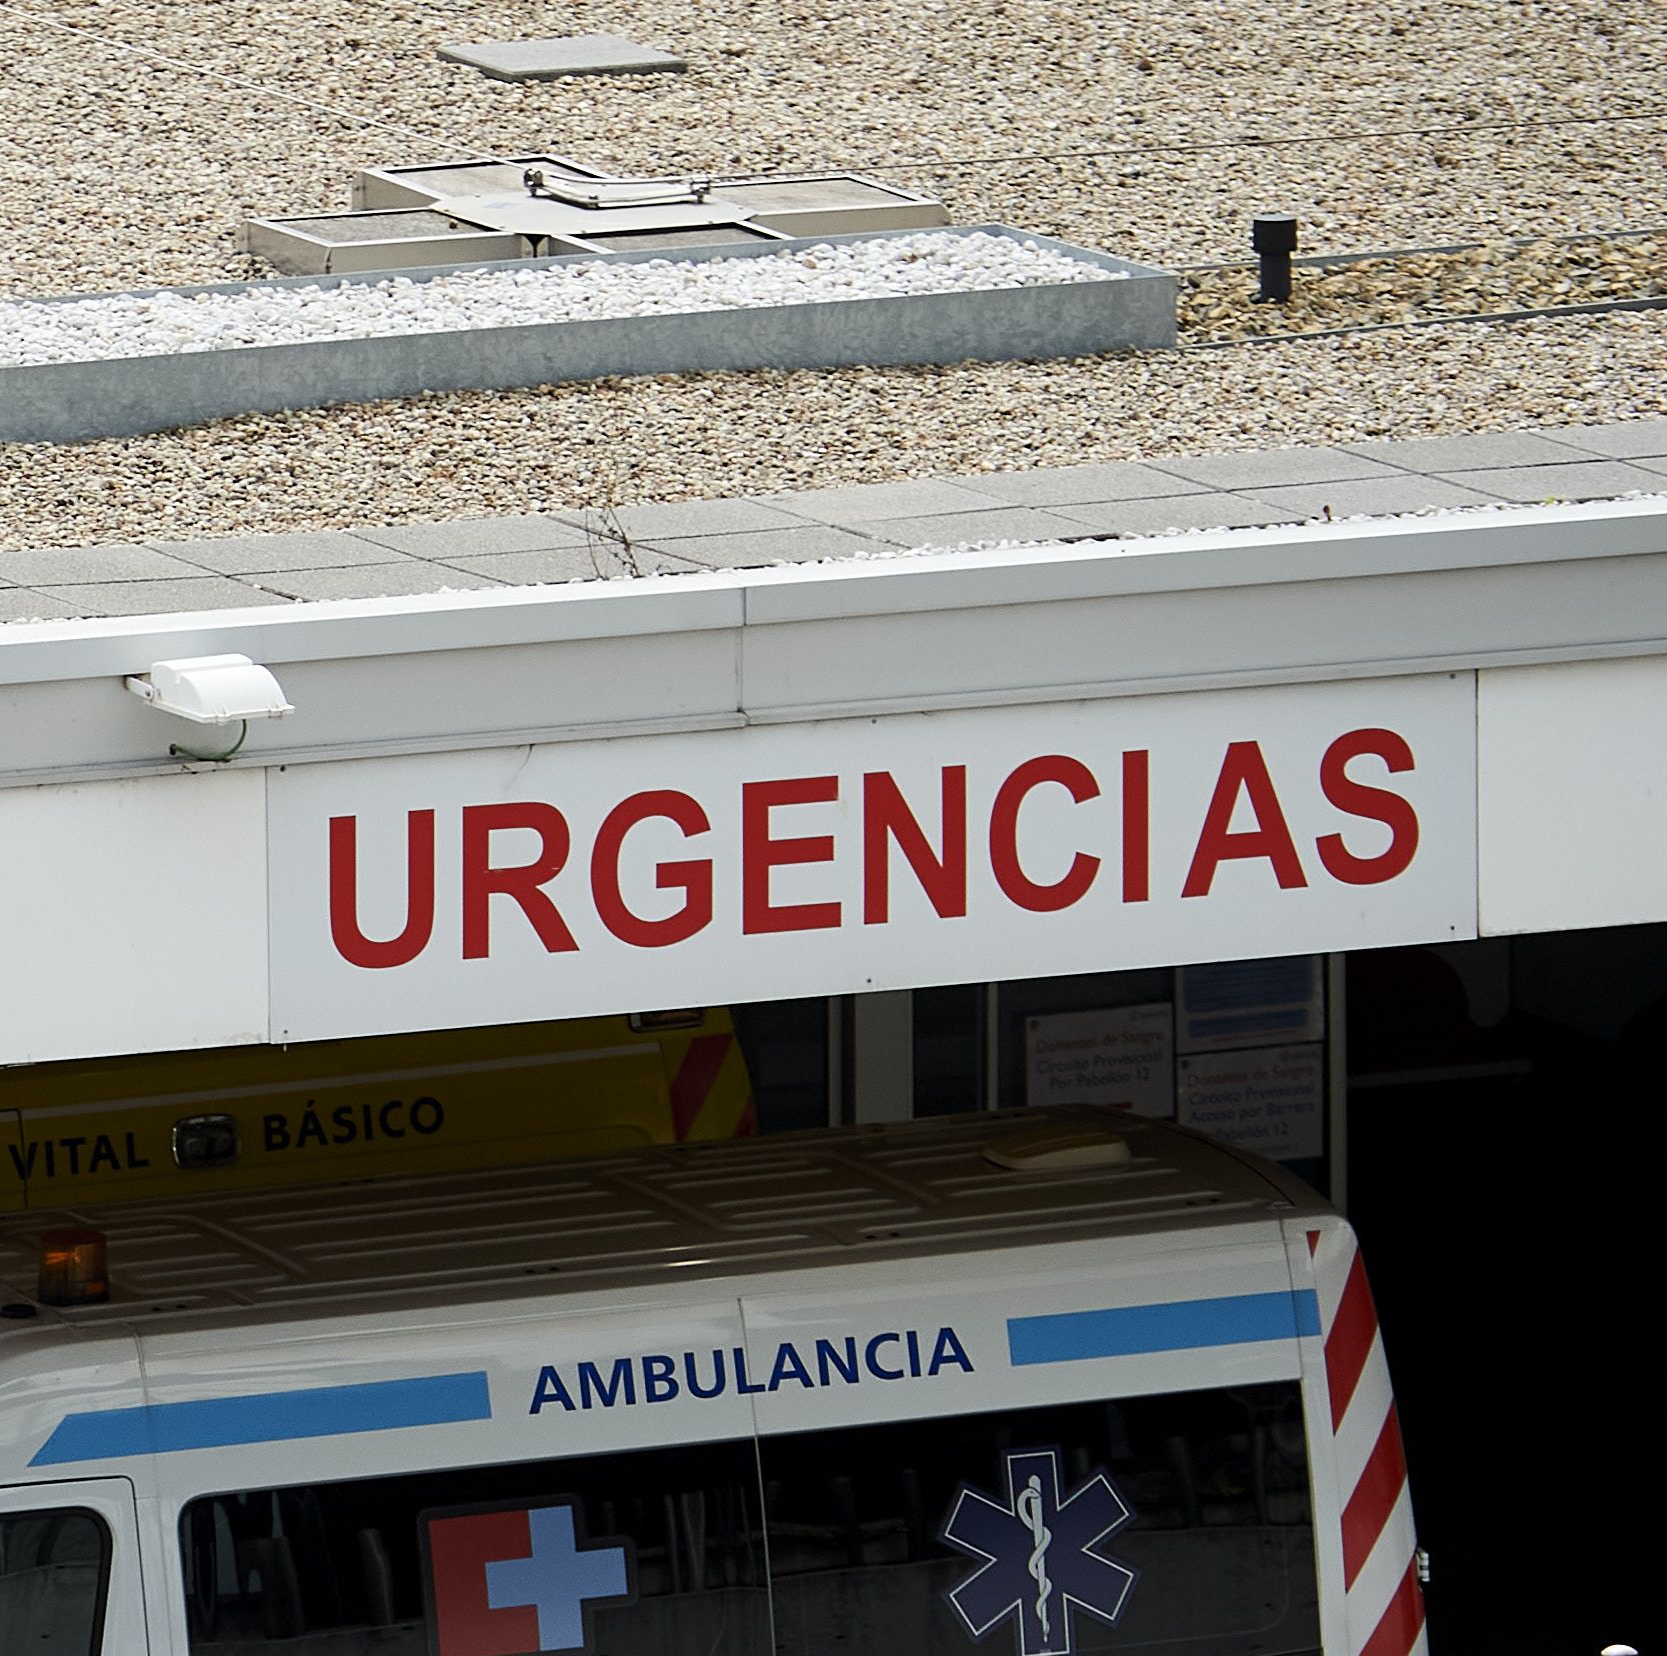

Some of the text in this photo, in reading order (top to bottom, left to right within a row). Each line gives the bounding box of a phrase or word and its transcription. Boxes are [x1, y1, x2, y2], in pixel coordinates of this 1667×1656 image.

[327, 727, 1421, 970] URGENCIAS
[9, 1130, 149, 1181] VITAL
[262, 1095, 444, 1151] BÁSICO
[529, 1326, 974, 1415] AMBULANCIA
